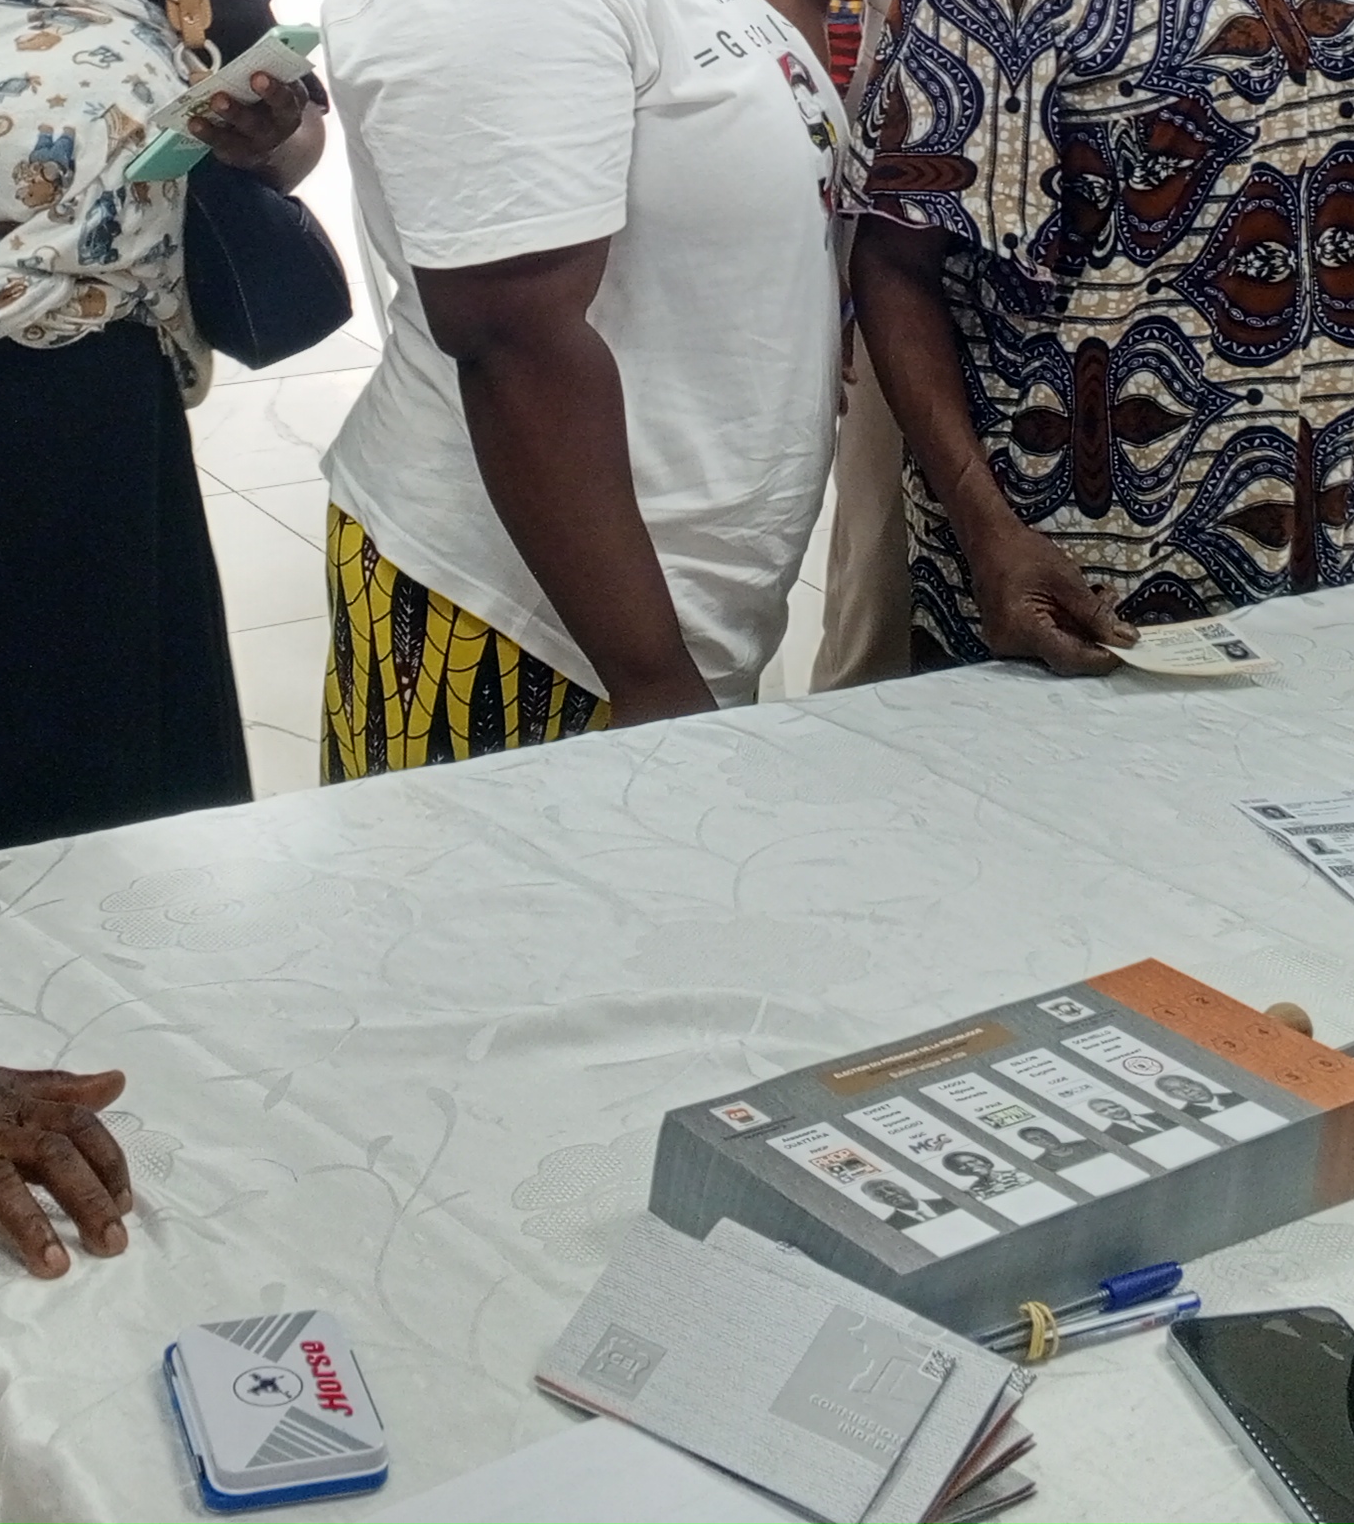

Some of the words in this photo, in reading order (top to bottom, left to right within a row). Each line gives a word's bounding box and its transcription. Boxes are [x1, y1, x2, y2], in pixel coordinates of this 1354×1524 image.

[783, 1132, 830, 1150] OUATTARA
[300, 1340, 354, 1417] Horse
[809, 1393, 906, 1445] COMMISSION
